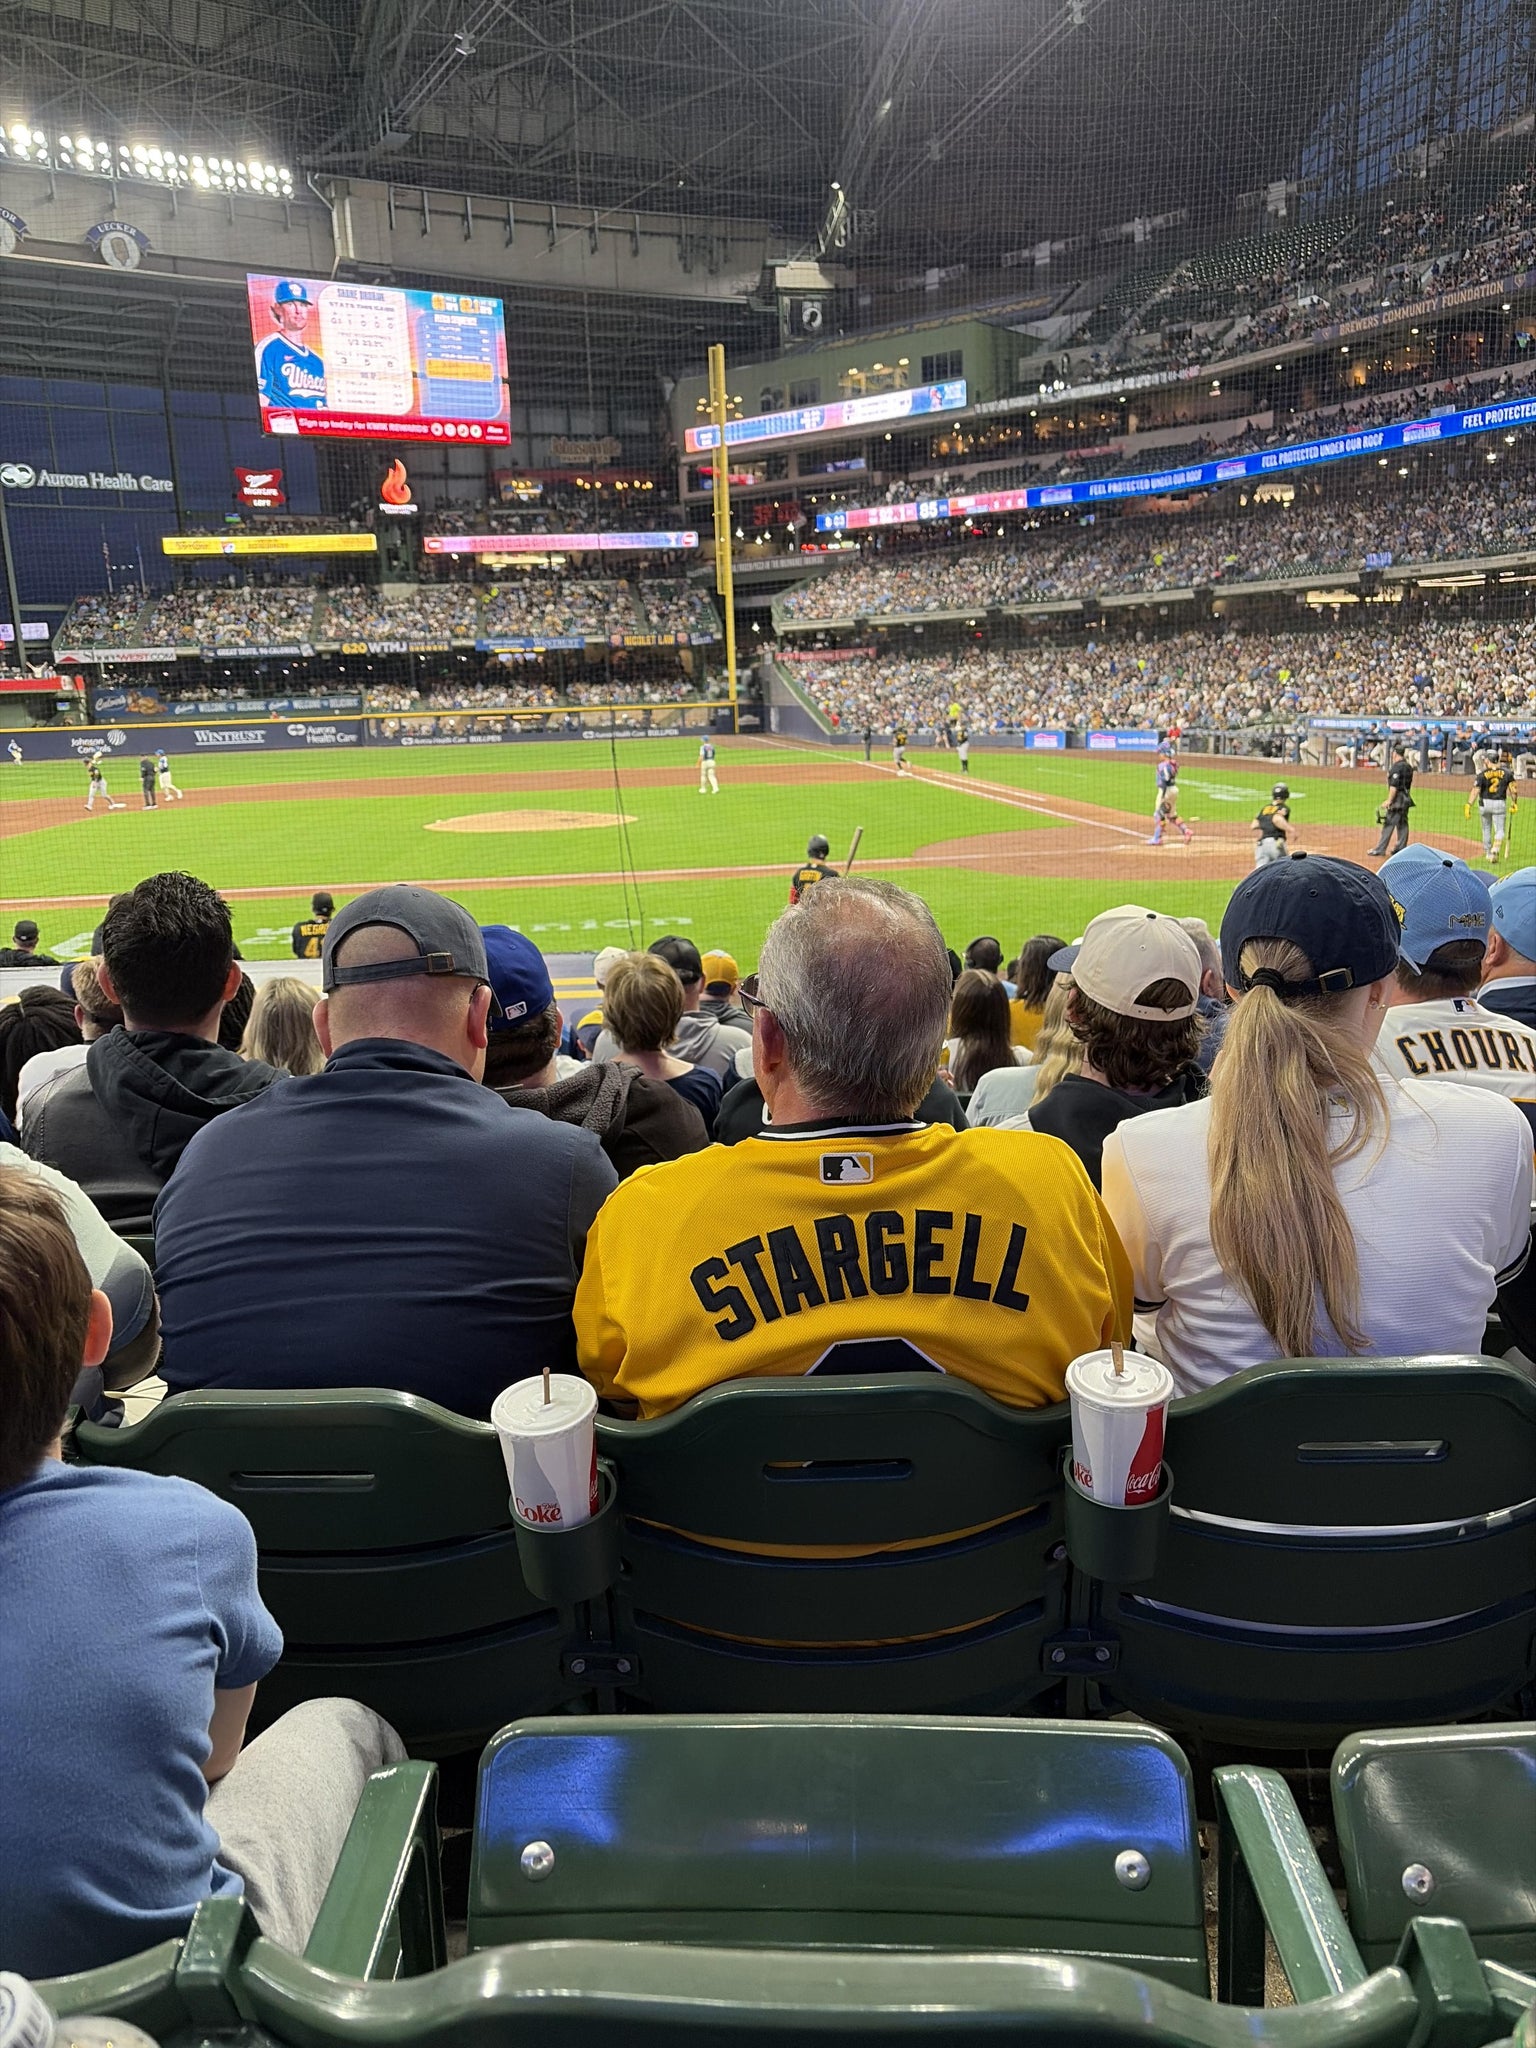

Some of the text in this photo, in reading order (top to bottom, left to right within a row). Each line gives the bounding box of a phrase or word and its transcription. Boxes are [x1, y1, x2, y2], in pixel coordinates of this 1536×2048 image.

[98, 222, 137, 236] UECKER
[1382, 298, 1438, 323] COMMUNITY
[1442, 280, 1504, 307] FOUNDATION
[1463, 413, 1484, 429] FEEL
[1262, 433, 1384, 469] FEEL PROTECTED UNDER OUR ROOF
[37, 469, 174, 492] Aurora Health Care
[1089, 483, 1107, 496] FEEL
[1107, 478, 1150, 495] PROTECTED
[1187, 469, 1202, 482] ROOF
[919, 502, 938, 518] 85
[342, 642, 368, 655] 620
[368, 642, 407, 653] WTMJ
[194, 730, 266, 743] WINTRUST
[306, 732, 358, 744] Health Care
[307, 725, 337, 735] Aurora
[71, 738, 105, 747] Johnson
[469, 735, 502, 743] BULLPEN
[1489, 777, 1499, 793] 2
[690, 1209, 1030, 1341] STARGELL
